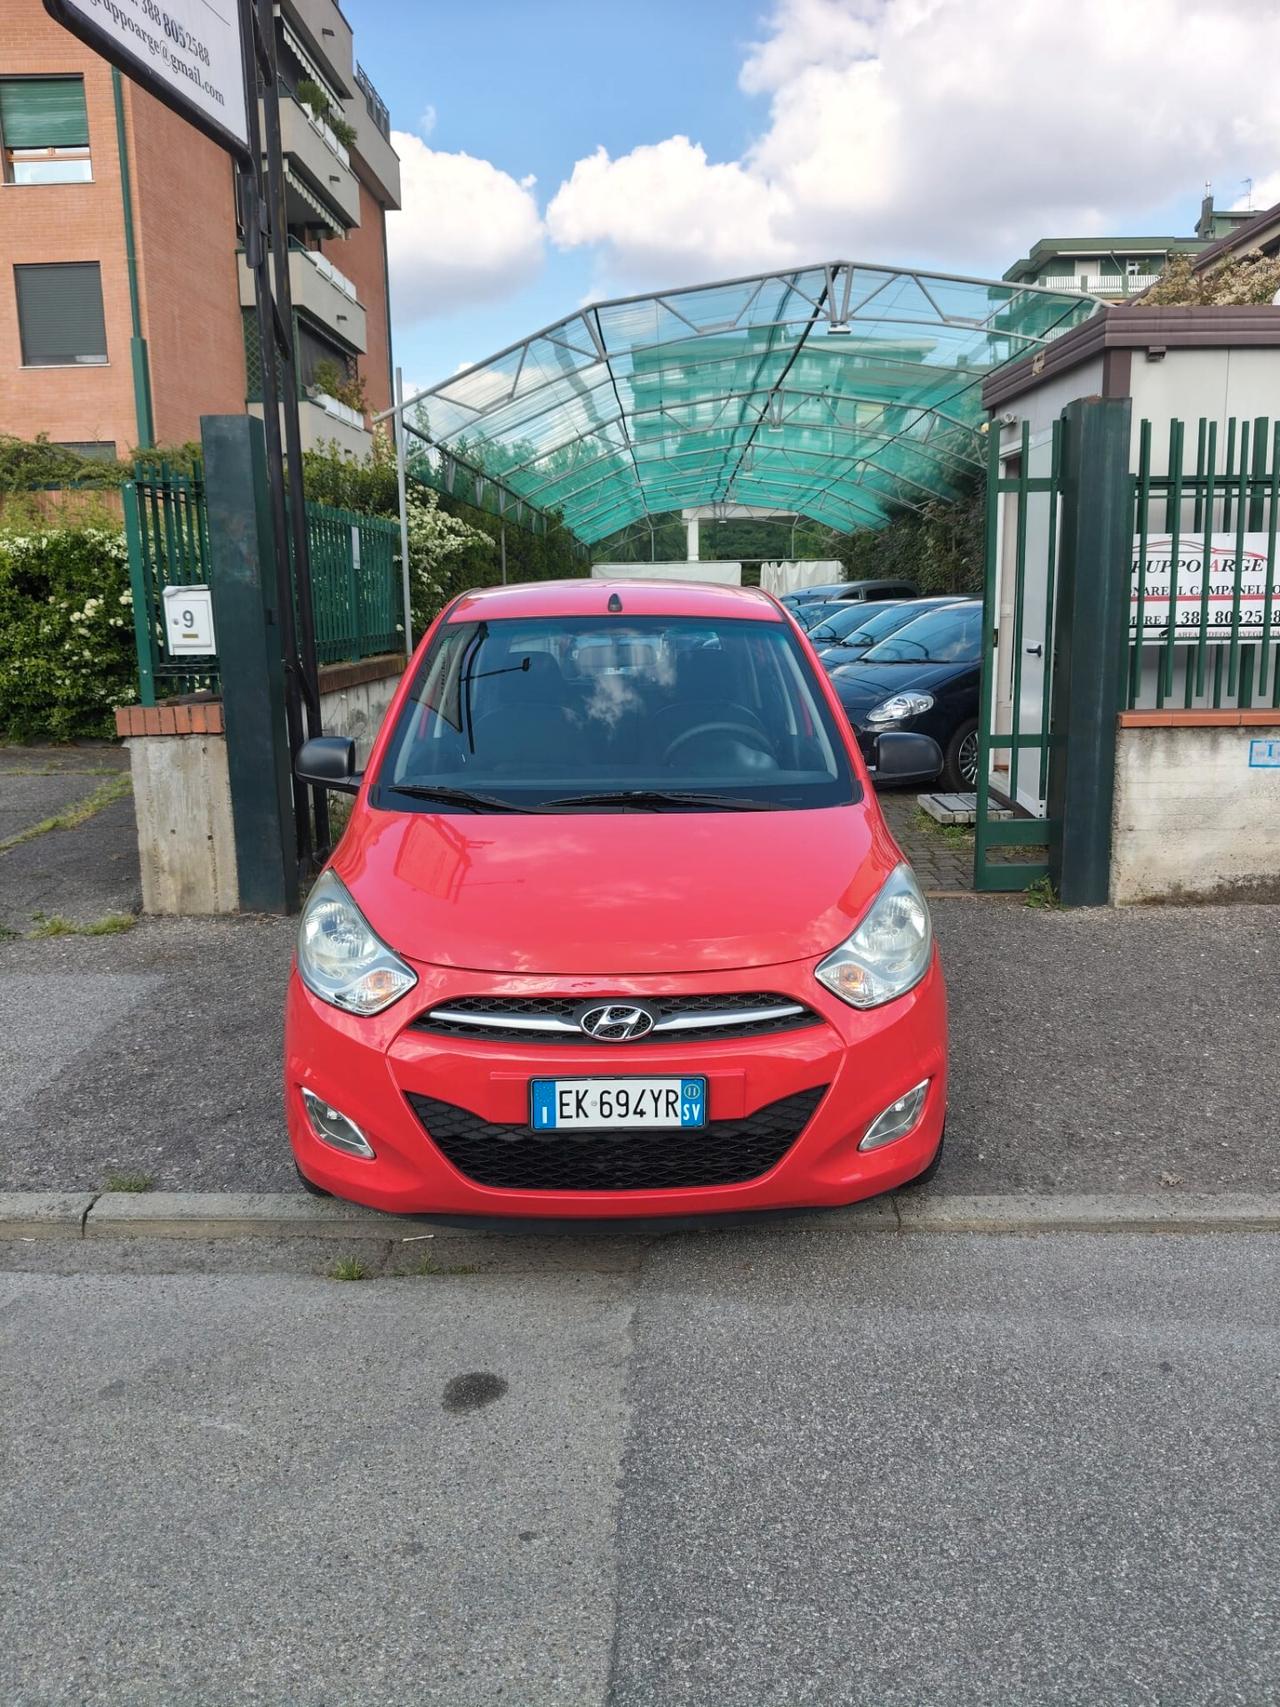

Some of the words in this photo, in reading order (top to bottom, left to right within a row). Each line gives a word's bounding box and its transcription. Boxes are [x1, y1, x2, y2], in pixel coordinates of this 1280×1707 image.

[142, 0, 161, 26] 388
[163, 12, 210, 67] 8052588
[90, 0, 225, 106] uppoarge@gmail.com
[182, 610, 194, 628] 9
[559, 1089, 589, 1119] EK
[599, 1089, 679, 1118] 694YR
[683, 1103, 701, 1121] SV
